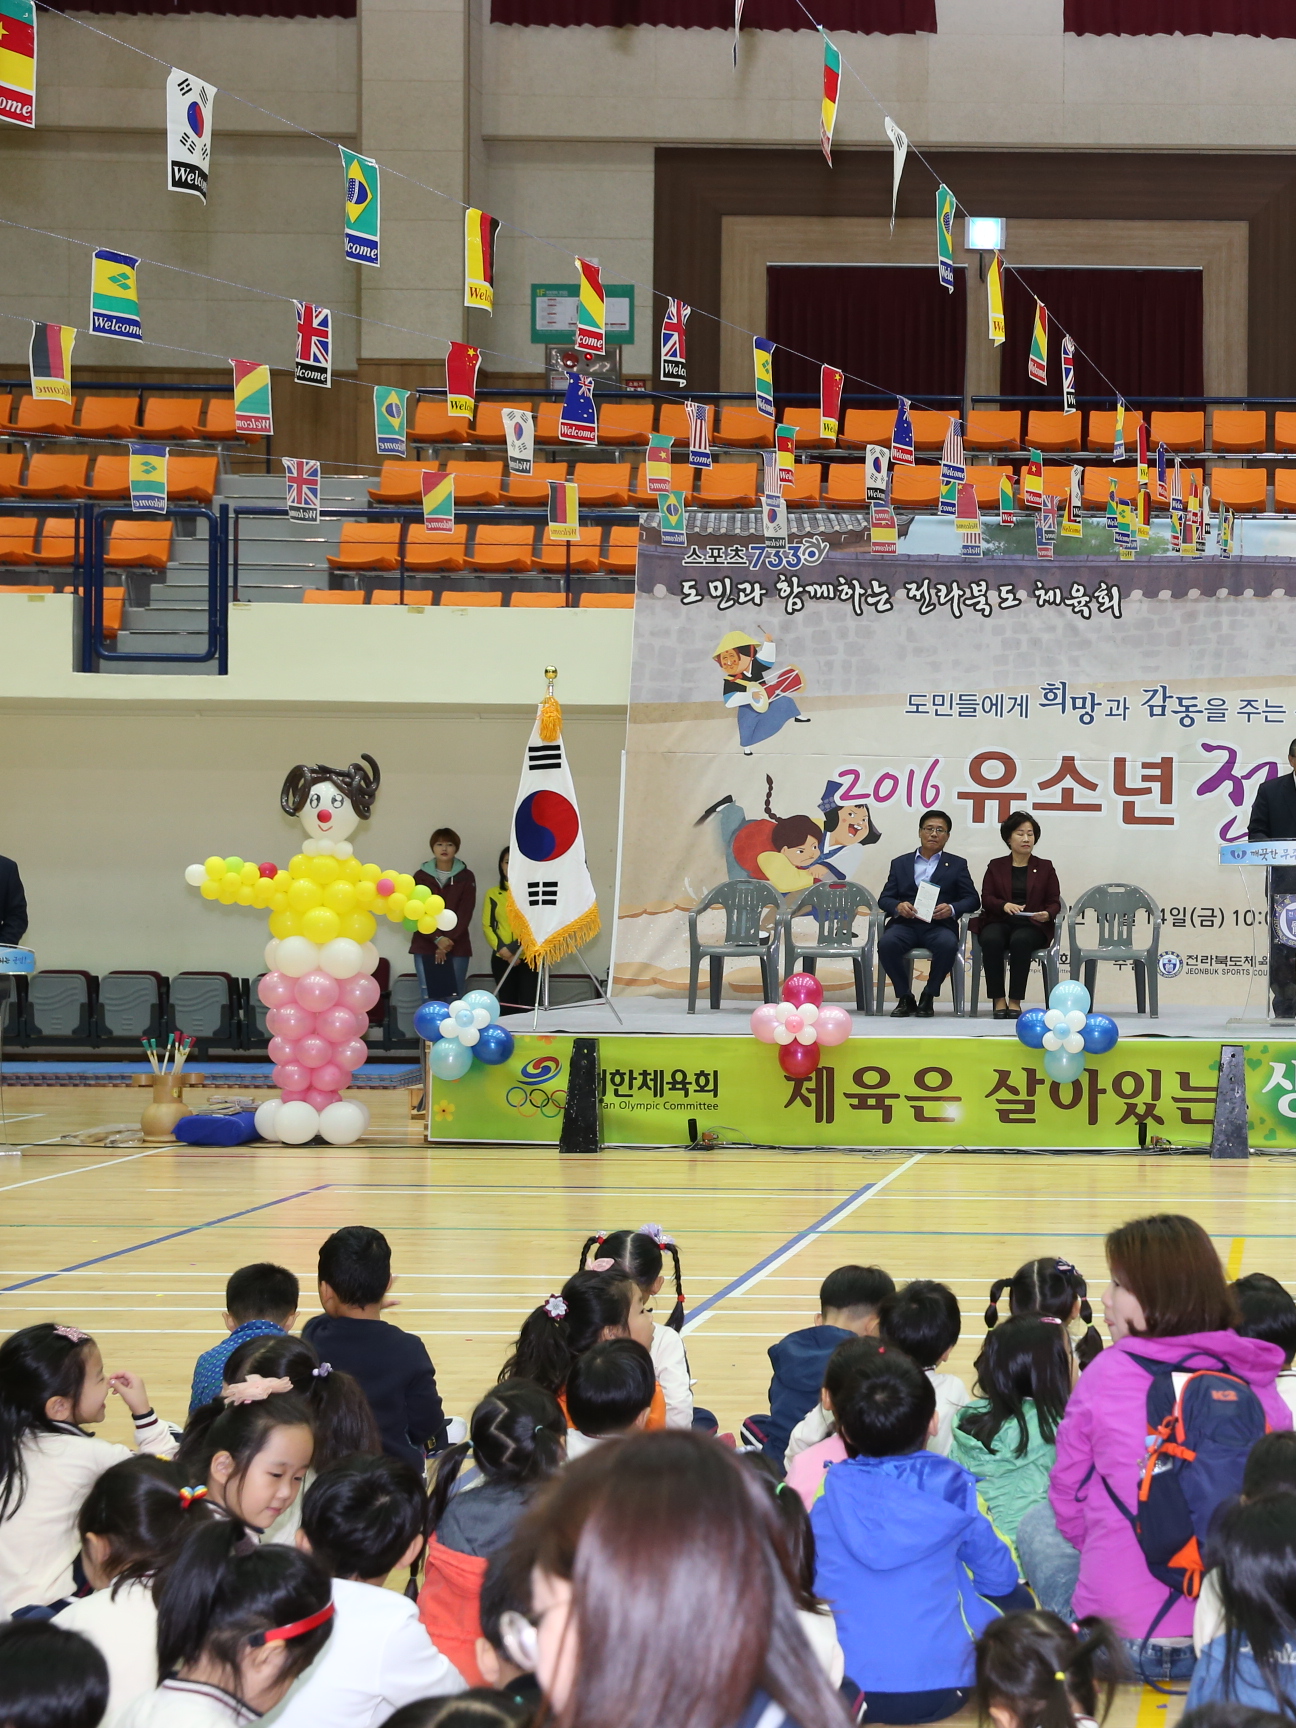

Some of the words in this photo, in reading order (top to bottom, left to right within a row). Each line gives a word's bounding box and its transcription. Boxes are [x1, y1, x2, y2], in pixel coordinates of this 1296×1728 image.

[561, 425, 596, 439] Welcome
[892, 449, 913, 462] Welcome
[681, 577, 766, 611] 도민과
[776, 574, 893, 615] 함께하는
[904, 577, 1023, 618] 전라북도
[1034, 581, 1122, 620] 체육회
[905, 692, 1029, 718] 도민들에게
[1038, 681, 1130, 725] 희망과
[1141, 685, 1230, 728] 감동을
[1236, 699, 1287, 724] 주는
[838, 758, 940, 808] 2016
[957, 750, 1175, 825] 유소년
[1186, 967, 1219, 975] JEONBUK
[1222, 968, 1250, 976] SPORTS
[619, 1101, 660, 1112] Olympic
[663, 1101, 719, 1111] Committee
[985, 1067, 1218, 1126] 살아있는
